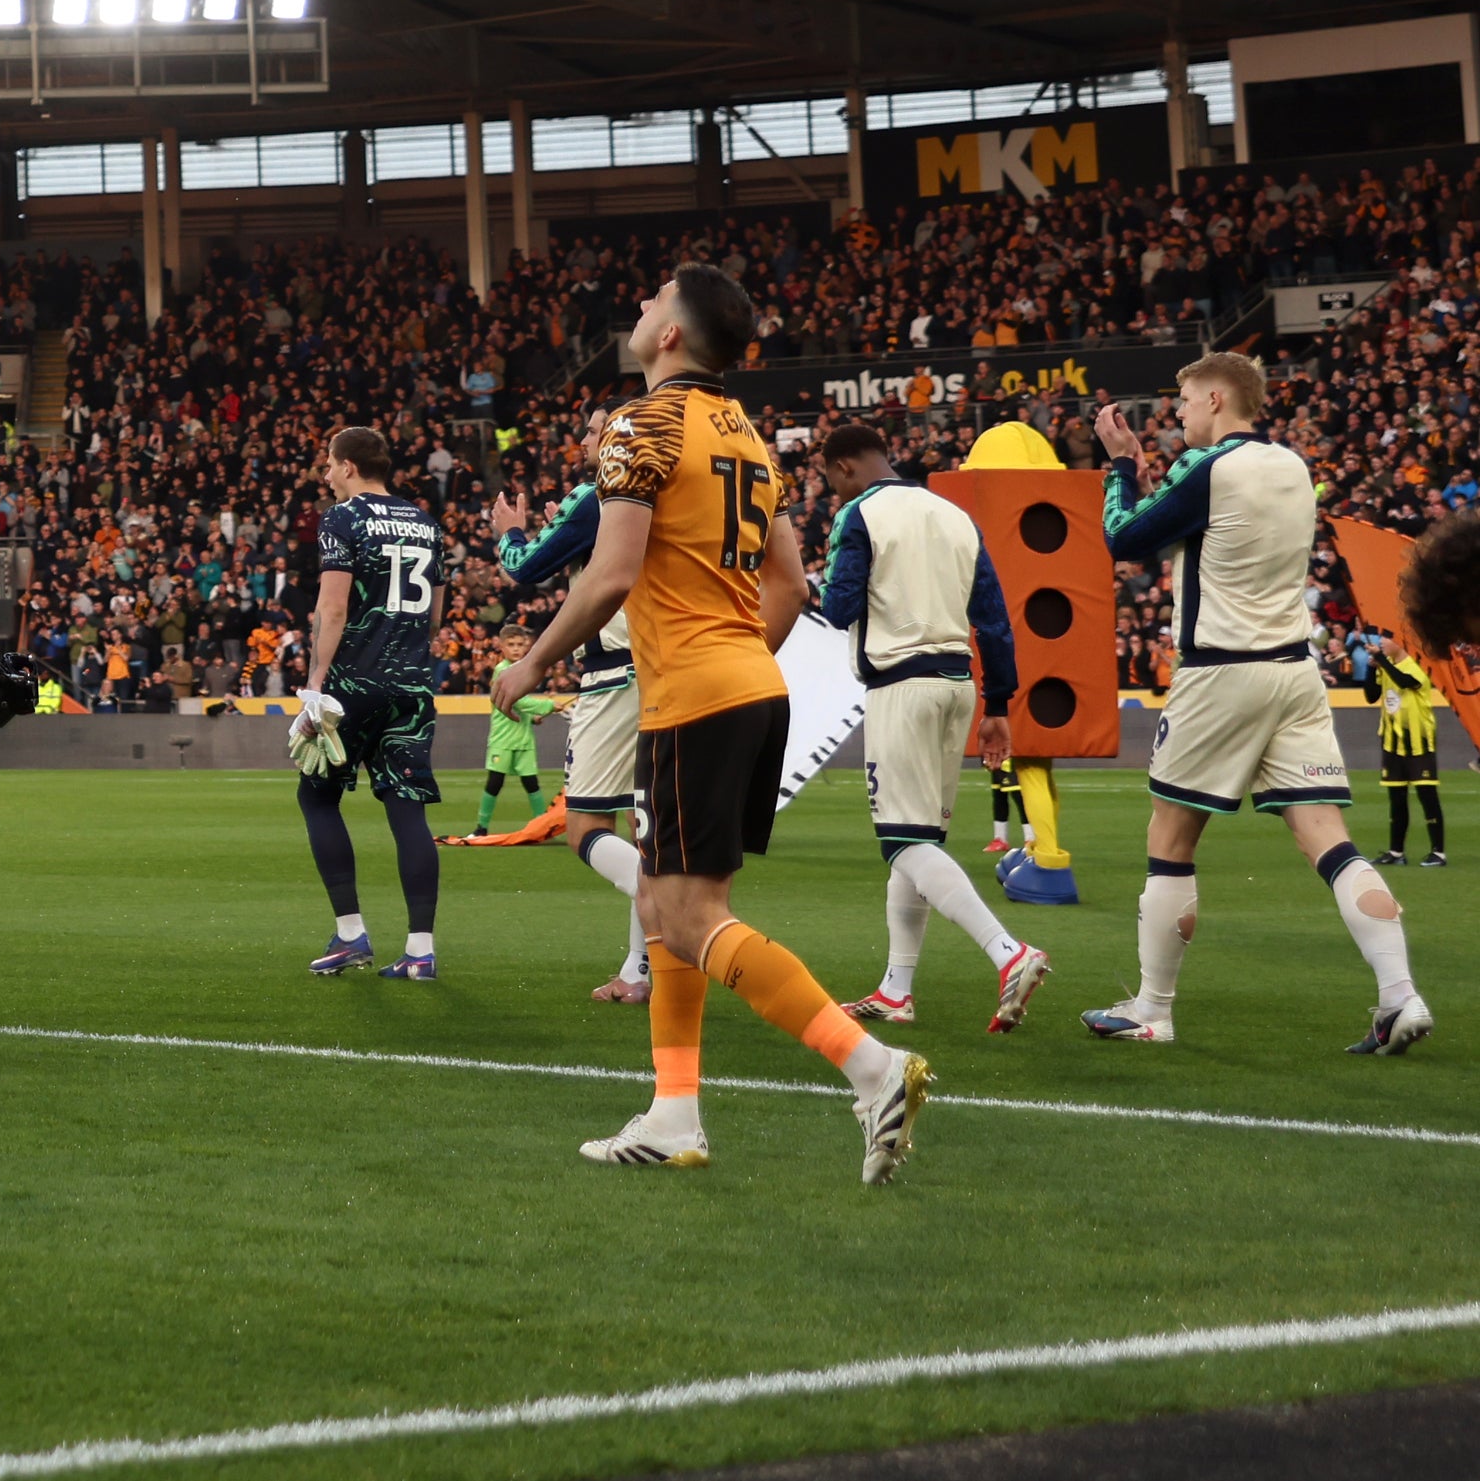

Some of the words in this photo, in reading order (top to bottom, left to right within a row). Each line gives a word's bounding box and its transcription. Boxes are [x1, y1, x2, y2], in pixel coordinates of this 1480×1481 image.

[916, 122, 1098, 205] MKM
[708, 408, 758, 444] EGAN
[365, 518, 435, 542] PATTERSON
[710, 454, 771, 572] 15
[381, 543, 433, 614] 13
